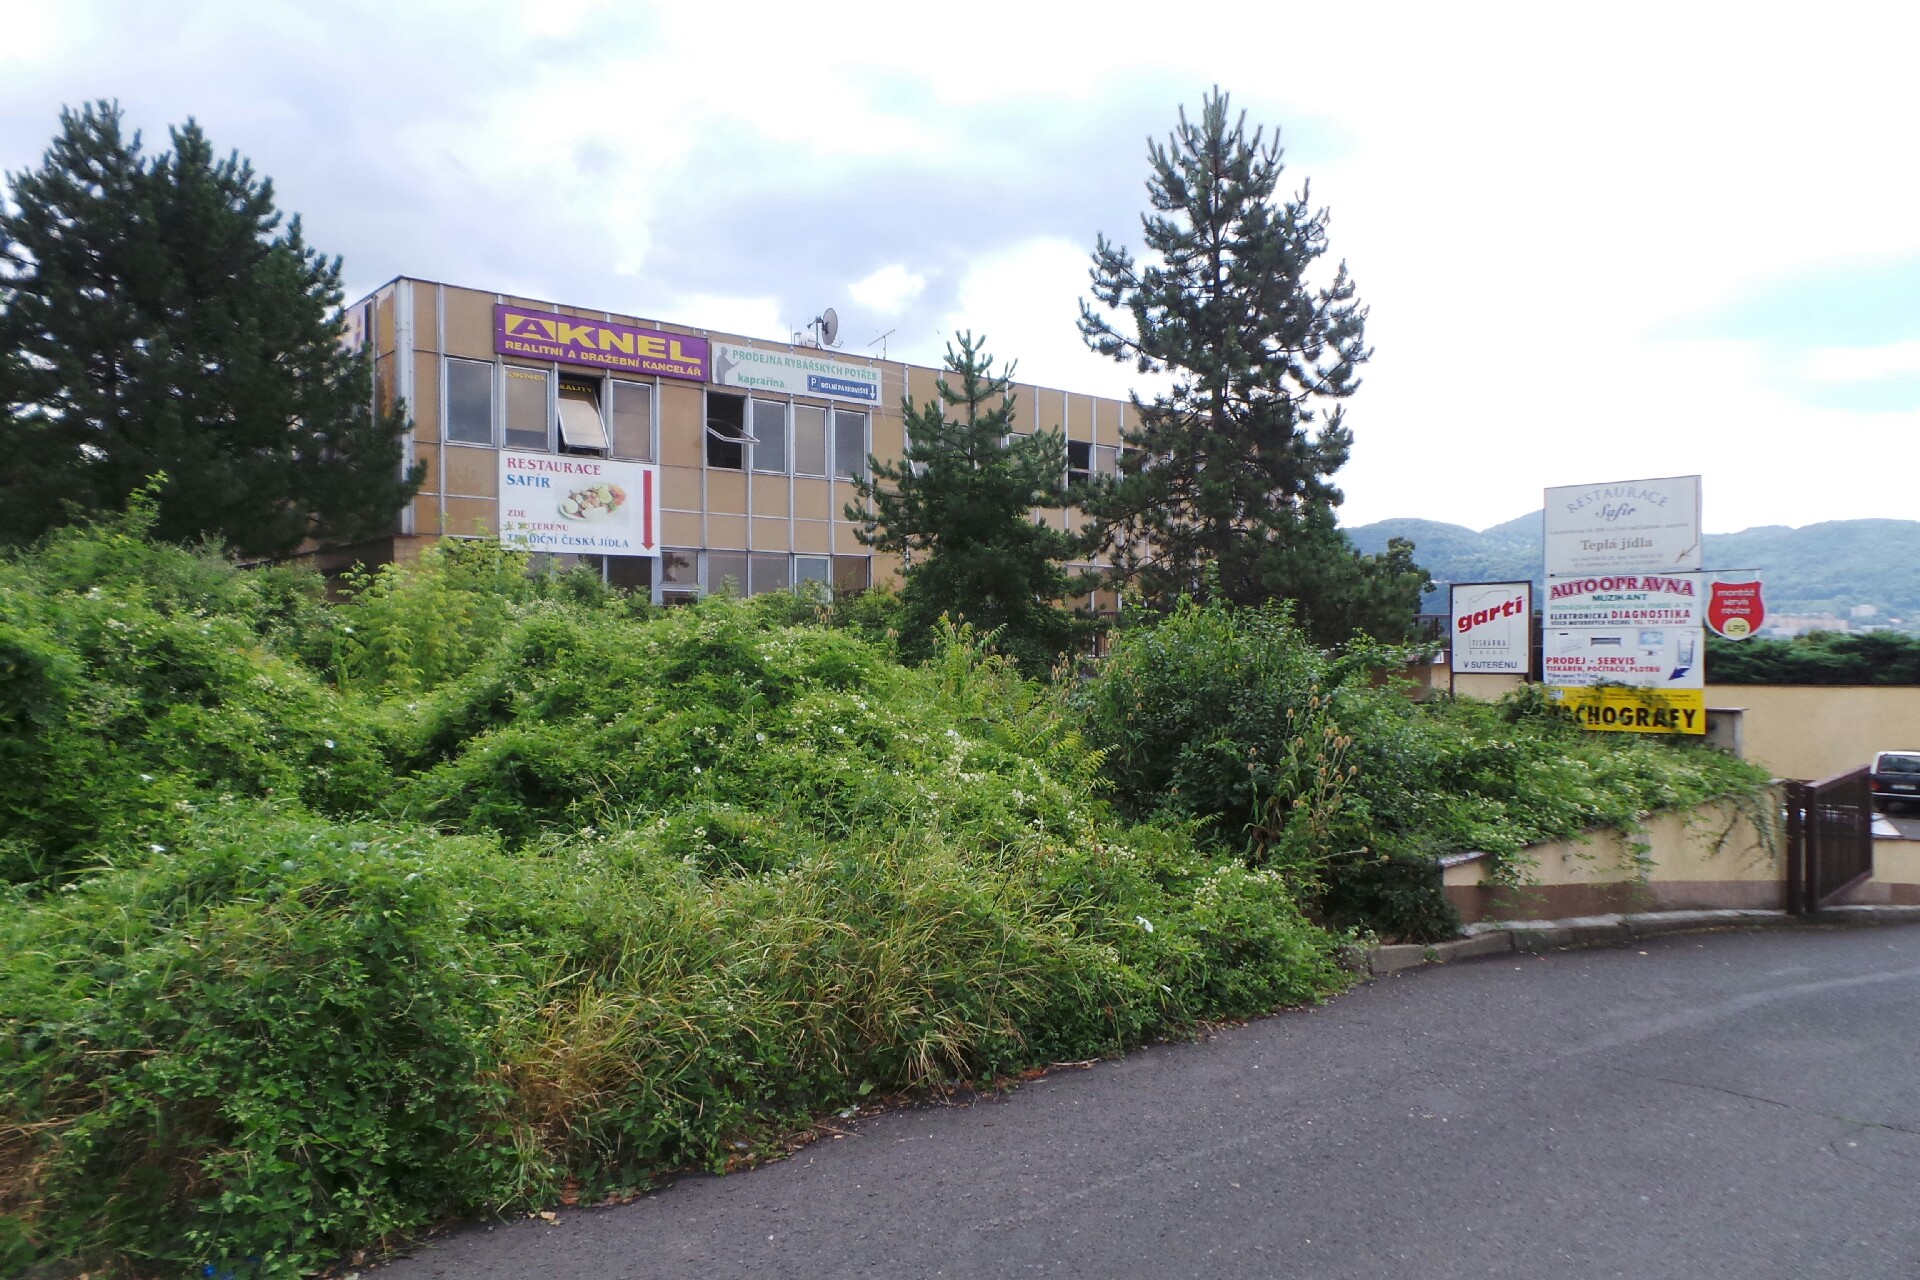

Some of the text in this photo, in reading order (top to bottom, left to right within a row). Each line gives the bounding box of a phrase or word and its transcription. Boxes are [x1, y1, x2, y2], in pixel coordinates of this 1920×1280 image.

[505, 313, 701, 365] AKNEL
[505, 340, 563, 357] REALITNÍ
[580, 351, 640, 368] DRAŽEBNÍ
[643, 360, 701, 377] KANCELÁŘ
[732, 350, 877, 381] PRODEJNA RYBÁŘSKÝCH POTŘEB
[559, 384, 592, 393] EALITY
[811, 377, 817, 388] P
[507, 457, 601, 476] RESTAURACE
[506, 473, 550, 488] SAFÍR
[1566, 486, 1669, 514] RESTAURACE
[507, 509, 527, 518] ZDE
[507, 533, 629, 548] TDIČNÍ ČESKÁ JÍDLA
[1580, 537, 1653, 552] Teplá jídla
[1549, 576, 1695, 600] AUTOOPRAVNA
[1592, 593, 1648, 602] MUZIKANT
[1457, 595, 1523, 634] garti
[1611, 609, 1691, 619] DIAGNOSTIKA
[1727, 624, 1746, 632] LPG
[1472, 638, 1506, 647] TISKÁRNA
[1463, 661, 1469, 669] V
[1546, 656, 1586, 665] PRODEJ
[1597, 656, 1636, 665] SERVIS
